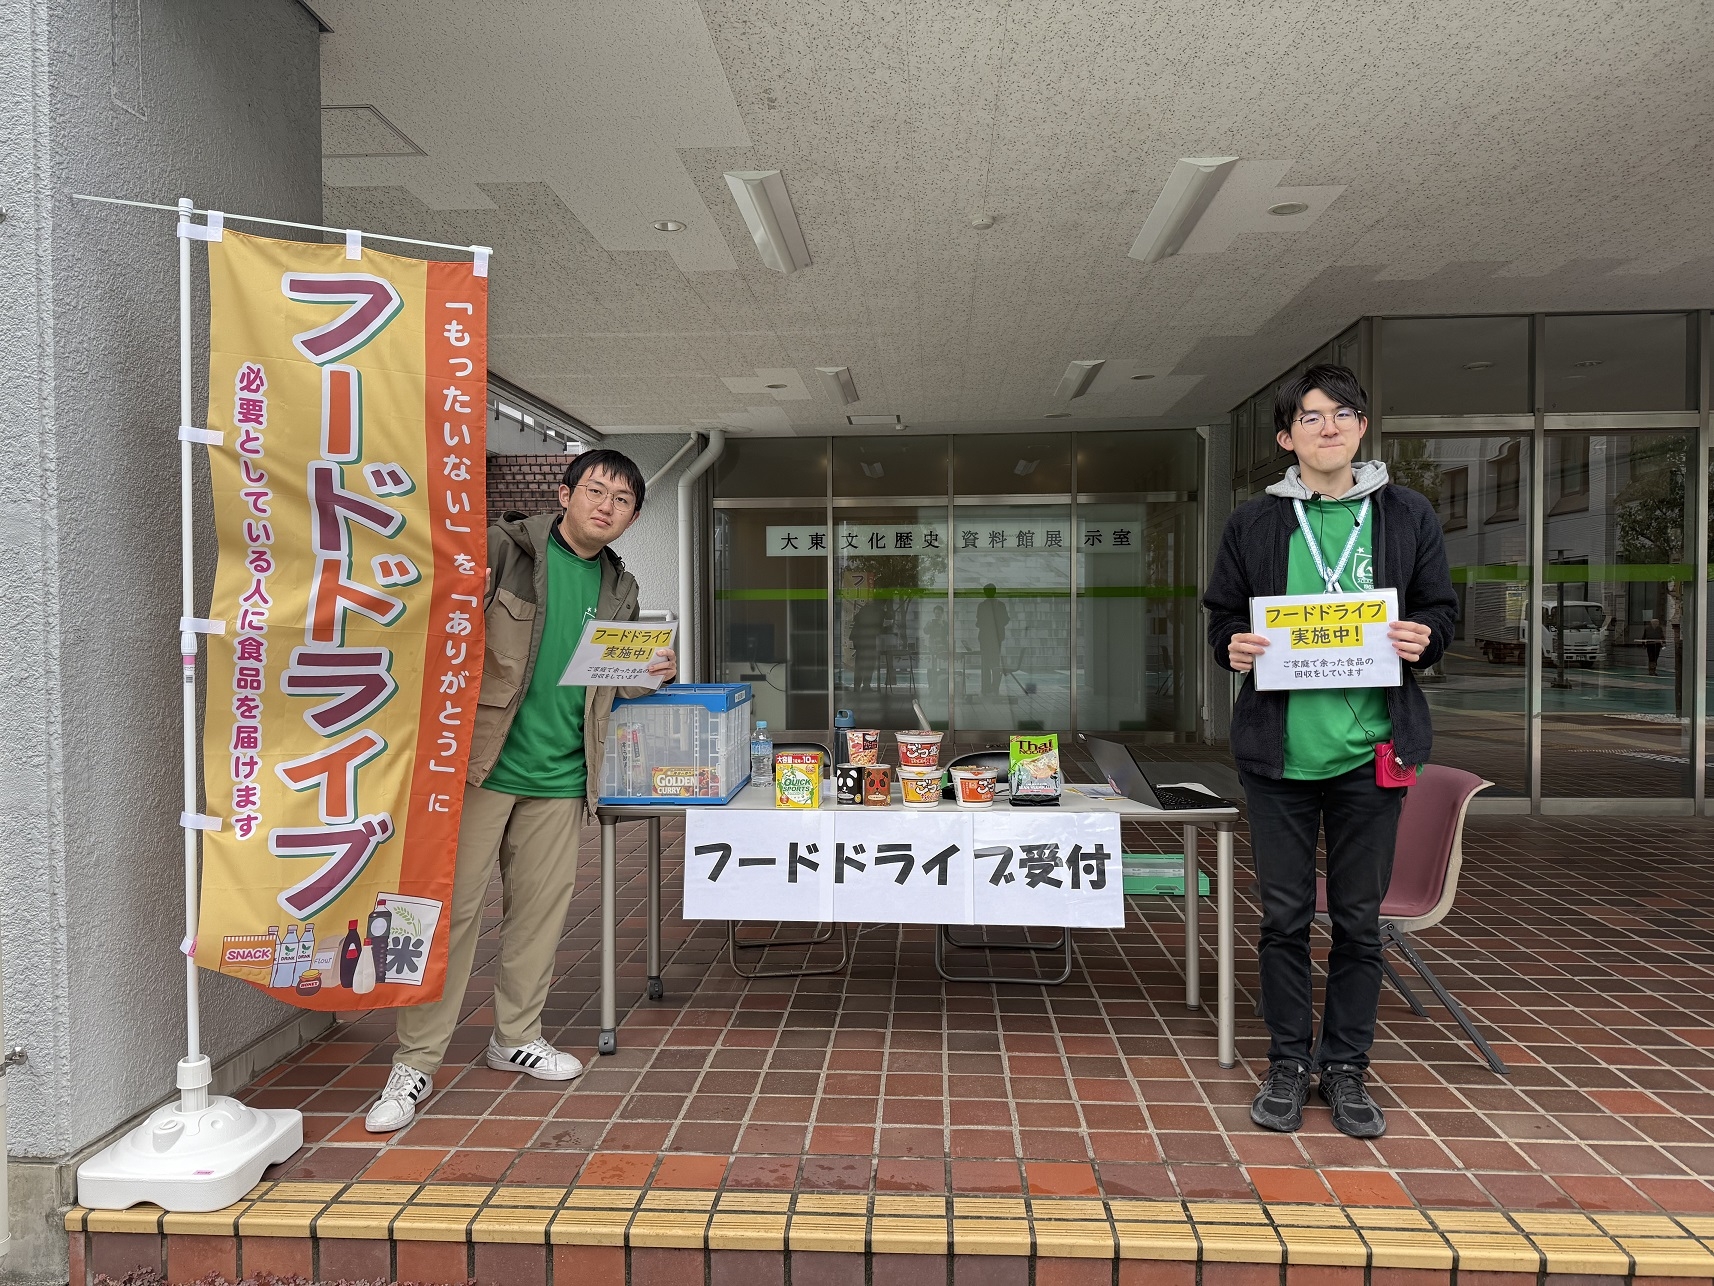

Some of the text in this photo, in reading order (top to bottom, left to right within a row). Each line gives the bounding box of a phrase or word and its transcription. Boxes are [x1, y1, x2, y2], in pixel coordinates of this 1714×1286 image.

[780, 529, 1132, 550] 大東文化歴史資料館展示室
[232, 363, 273, 840] 必要としている人に食品を届けます
[270, 272, 418, 920] フードドライブ
[1266, 600, 1386, 623] フードドライブ
[595, 629, 672, 643] フードドライブ
[1291, 625, 1360, 646] 実施中!
[603, 646, 652, 659] 実施中!
[1283, 657, 1374, 668] ご家庭で余った食品の
[587, 666, 649, 674] ご家庭で余った食品の
[1294, 668, 1363, 678] 回収をしています
[784, 778, 811, 787] QUICK
[657, 786, 681, 794] CURRY
[694, 842, 1111, 890] フードドライブ受付
[226, 948, 272, 962] SNACK
